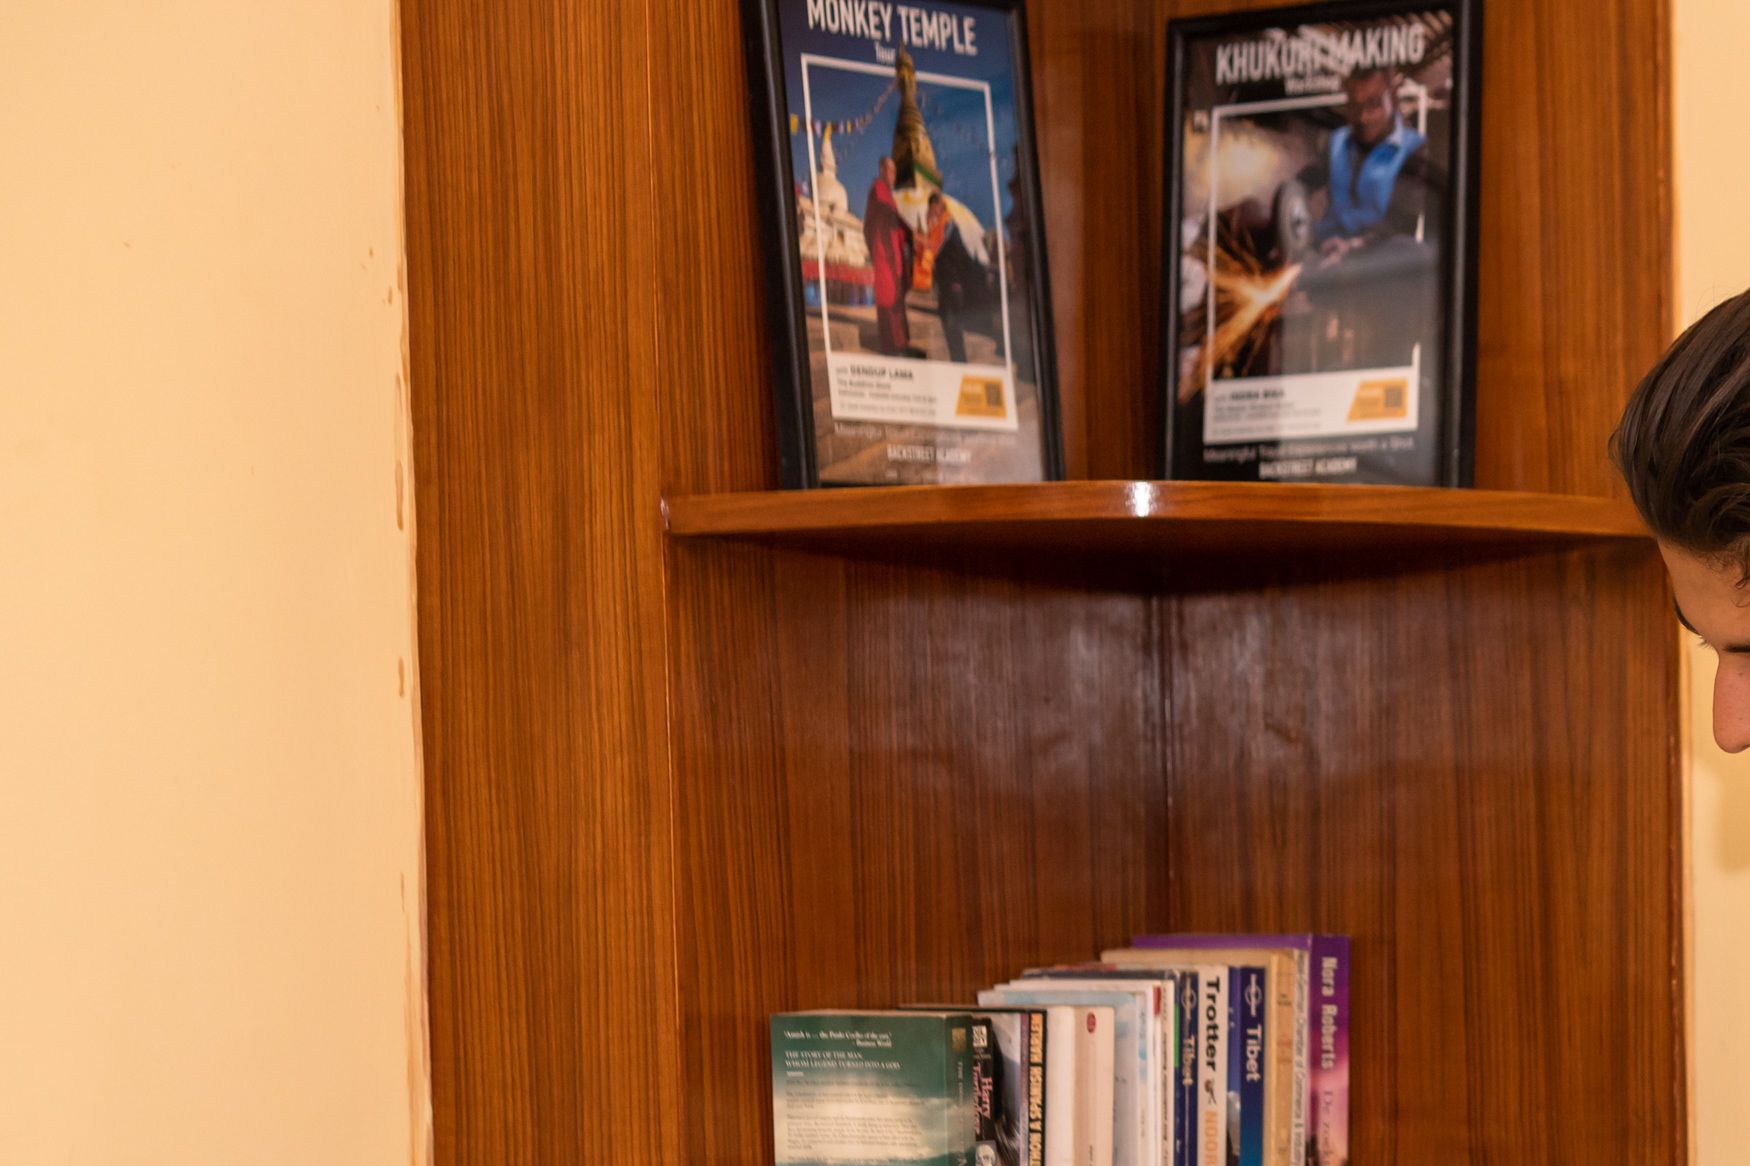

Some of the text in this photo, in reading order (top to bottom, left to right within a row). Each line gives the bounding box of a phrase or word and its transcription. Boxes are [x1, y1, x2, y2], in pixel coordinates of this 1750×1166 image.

[806, 0, 978, 56] MONKEY TEMPLE
[1329, 23, 1425, 76] MAKING
[1030, 1012, 1043, 1063] HARLEM
[1206, 975, 1220, 1073] Trotter
[1321, 956, 1338, 1070] Nora Roberts
[1182, 1034, 1195, 1086] Tibet
[1246, 1024, 1262, 1083] Tibet
[981, 1076, 993, 1119] Harry
[1029, 1066, 1043, 1120] SPANISH
